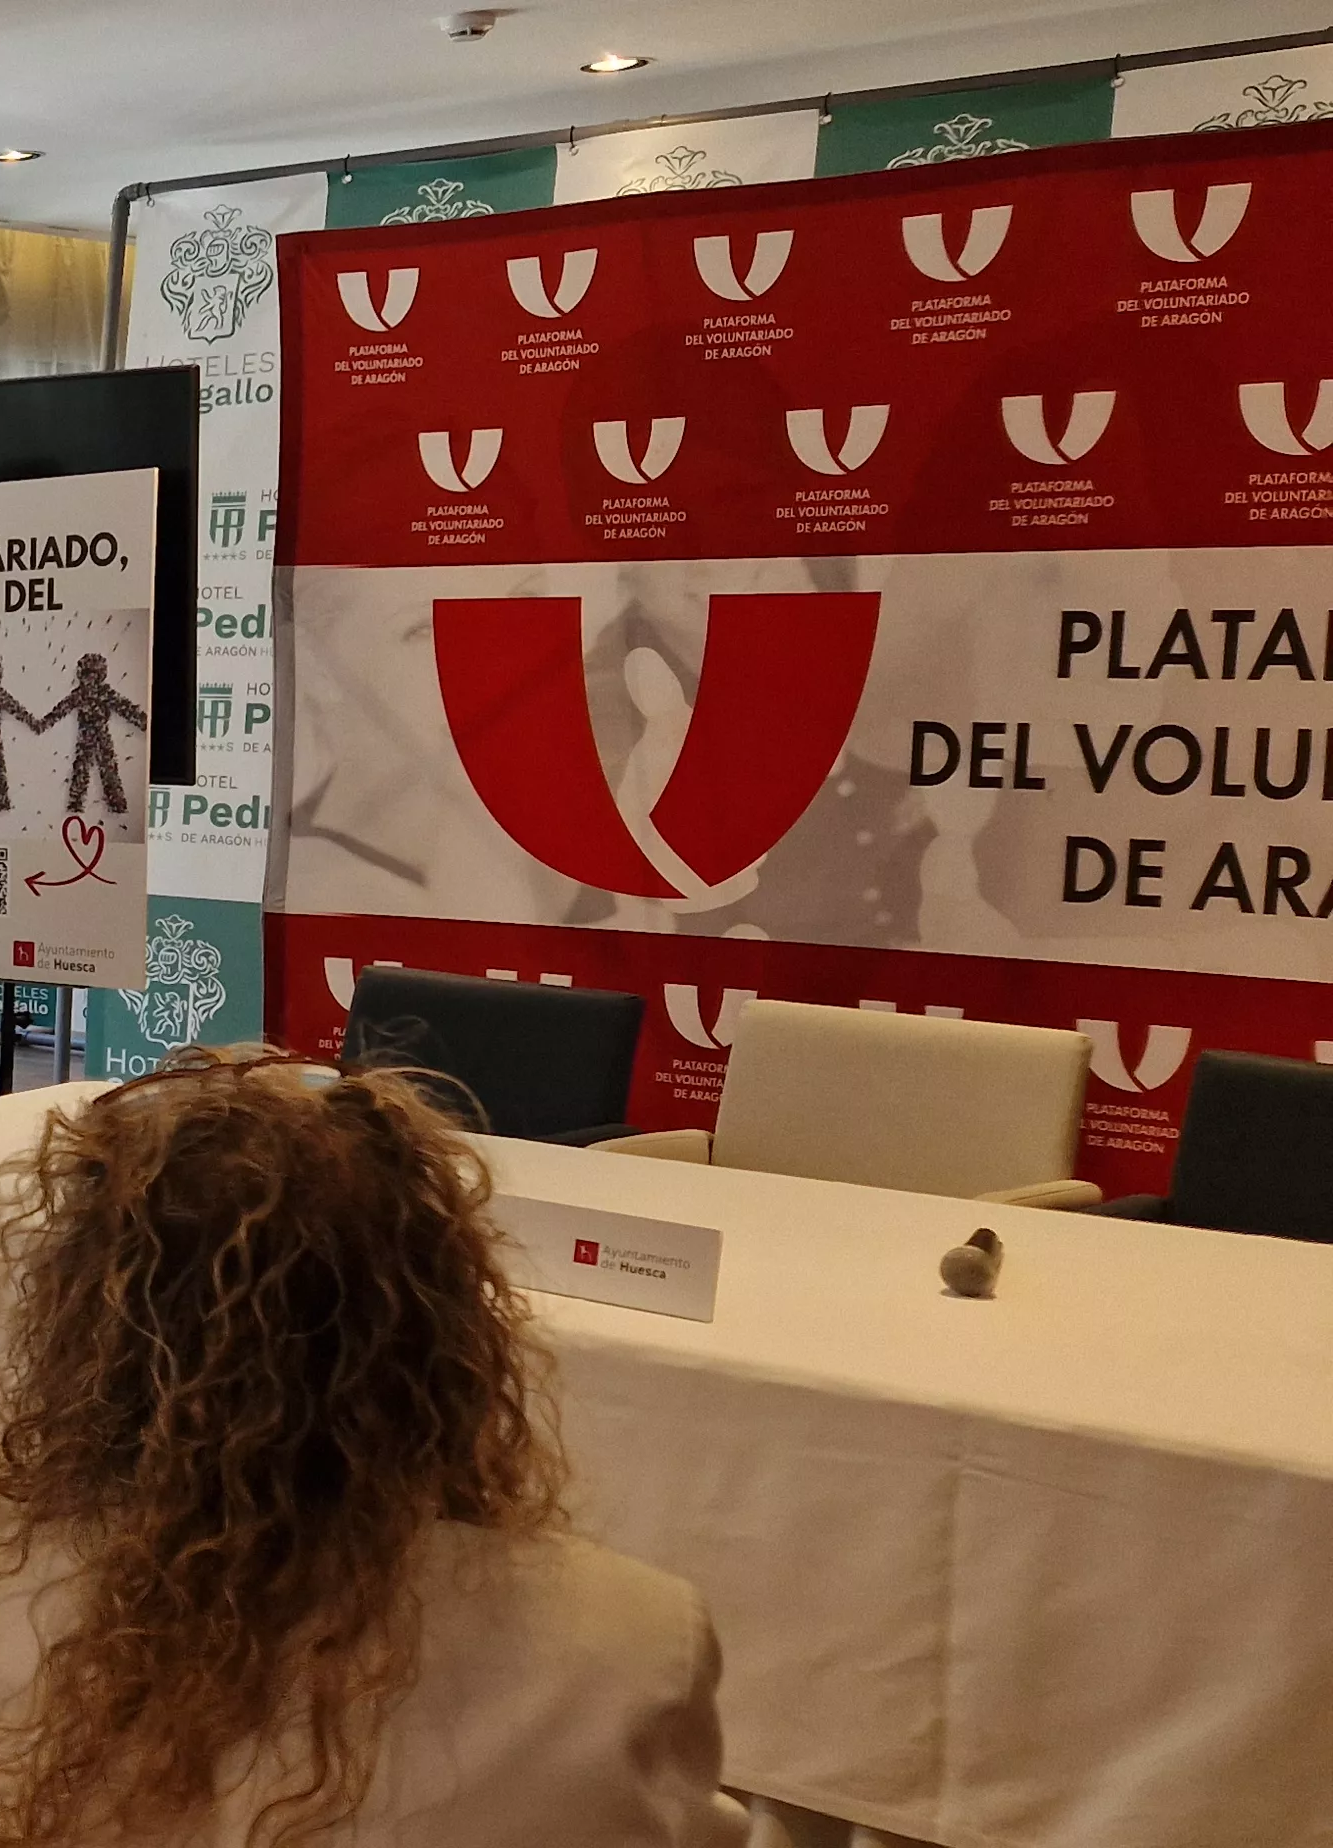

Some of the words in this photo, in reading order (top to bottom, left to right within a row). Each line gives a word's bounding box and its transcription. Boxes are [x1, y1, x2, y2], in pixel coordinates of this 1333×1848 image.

[1140, 276, 1228, 293] PLATAFORMA
[912, 294, 991, 312] PLATAFORMA
[1117, 300, 1141, 312] DEL
[1144, 292, 1249, 310] VOLUNTARIADO
[703, 313, 776, 329] PLATAFORMA
[891, 319, 911, 330] DEL
[915, 310, 1011, 328] VOLUNTARIADO
[1141, 316, 1158, 327] DE
[1161, 310, 1222, 326] ARAGÓN
[518, 329, 583, 345] PLATAFORMA
[685, 334, 704, 345] DEL
[706, 329, 793, 344] VOLUNTARIADO
[912, 333, 928, 344] DE
[930, 326, 986, 343] ARAGÓN
[349, 344, 408, 356] PLATAFORMA
[501, 350, 519, 361] DEL
[520, 343, 599, 360] VOLUNTARIADO
[705, 349, 719, 360] DE
[721, 344, 771, 359] ARAGÓN
[335, 361, 350, 372] DEL
[352, 357, 423, 370] VOLUNTARIADO
[519, 364, 532, 374] DE
[534, 359, 579, 373] ARAGÓN
[351, 374, 363, 385] DE
[365, 372, 406, 384] ARAGÓN
[1011, 480, 1093, 493] PLATAFORMA
[795, 489, 870, 501] PLATAFORMA
[1224, 492, 1248, 503] DEL
[427, 505, 489, 516] PLATAFORMA
[602, 497, 669, 509] PLATAFORMA
[989, 499, 1010, 511] DEL
[1014, 496, 1114, 509] VOLUNTARIADO
[585, 514, 603, 525] DEL
[605, 512, 686, 524] VOLUNTARIADO
[776, 507, 796, 518] DEL
[798, 504, 889, 517] VOLUNTARIADO
[1249, 508, 1268, 520] DE
[411, 522, 427, 531] DEL
[429, 519, 504, 531] VOLUNTARIADO
[796, 522, 811, 533] DE
[813, 519, 866, 532] ARAGÓN
[1012, 515, 1028, 526] DE
[1031, 512, 1089, 525] ARAGÓN
[428, 535, 440, 545] DE
[442, 533, 485, 544] ARAGÓN
[604, 529, 618, 539] DE
[619, 525, 666, 538] ARAGÓN
[5, 578, 63, 612] DEL
[197, 604, 272, 638] Ped
[205, 644, 256, 656] ARAGÓN
[243, 743, 259, 752] DE
[910, 721, 1045, 790] DEL
[181, 833, 197, 843] DE
[200, 833, 251, 846] ARAGÓN
[1063, 836, 1166, 907] DE
[38, 942, 115, 960] Ayuntamiento
[38, 959, 51, 969] de
[53, 960, 95, 973] Huesca
[655, 1072, 672, 1083] DEL
[674, 1088, 688, 1099] DE
[1086, 1103, 1169, 1121] PLATAFORMA
[1090, 1120, 1180, 1138] VOLUNTARIAD
[602, 1246, 690, 1269] Ayuntamiento
[601, 1261, 615, 1269] de
[620, 1263, 666, 1279] Huesca
